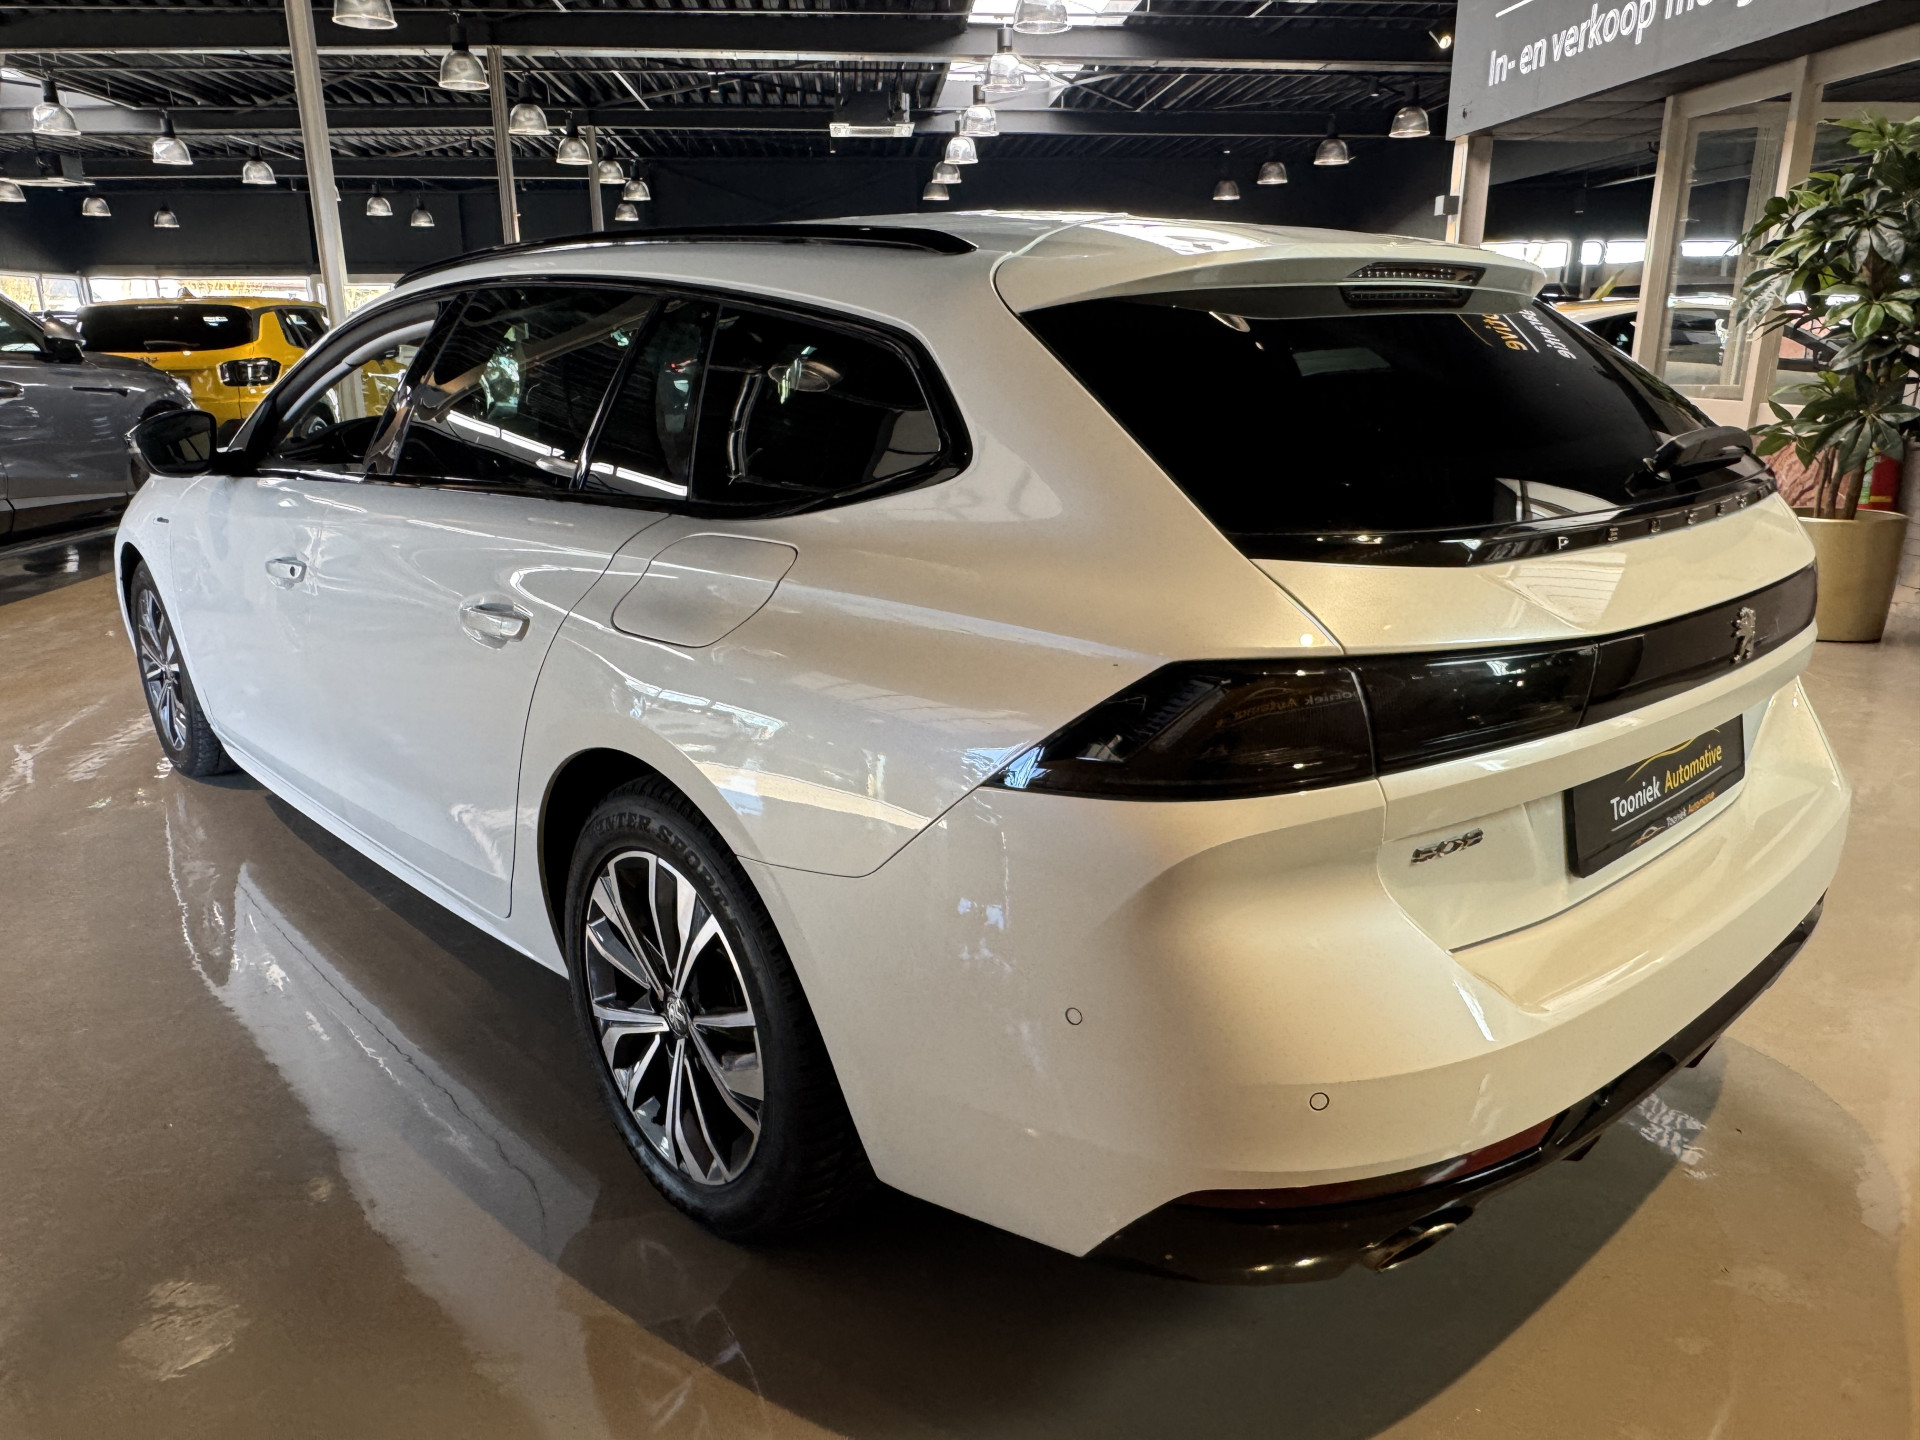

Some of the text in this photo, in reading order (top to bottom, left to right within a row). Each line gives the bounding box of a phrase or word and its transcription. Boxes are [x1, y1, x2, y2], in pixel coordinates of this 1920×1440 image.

[1488, 50, 1516, 86] In-
[1519, 38, 1547, 74] en
[1551, 0, 1656, 62] verkoop
[1610, 743, 1722, 821] Tooniek Automotive
